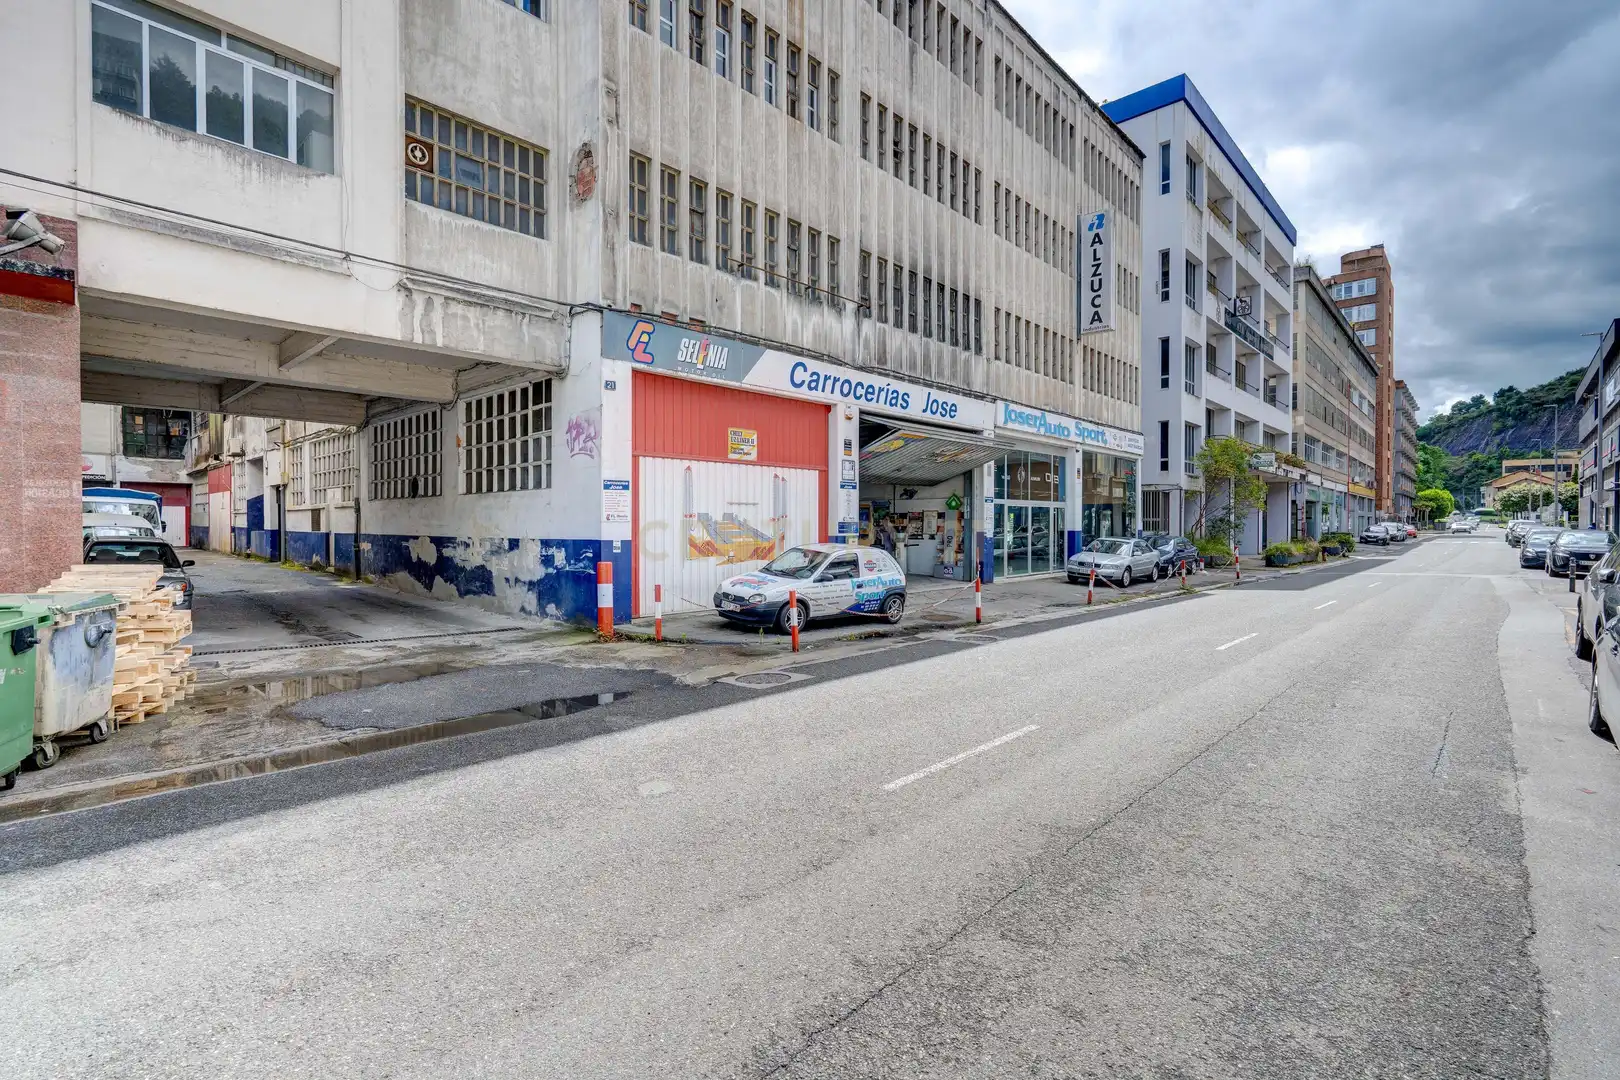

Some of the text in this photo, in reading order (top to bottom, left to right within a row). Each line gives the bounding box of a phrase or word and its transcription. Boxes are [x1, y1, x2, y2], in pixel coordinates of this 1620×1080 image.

[1089, 232, 1104, 325] ALZUCA
[677, 336, 730, 371] SELENIA
[677, 366, 726, 379] MOTOR OIL
[605, 381, 616, 390] 21
[789, 361, 958, 419] Carrocerías Jose
[855, 590, 887, 605] Sport
